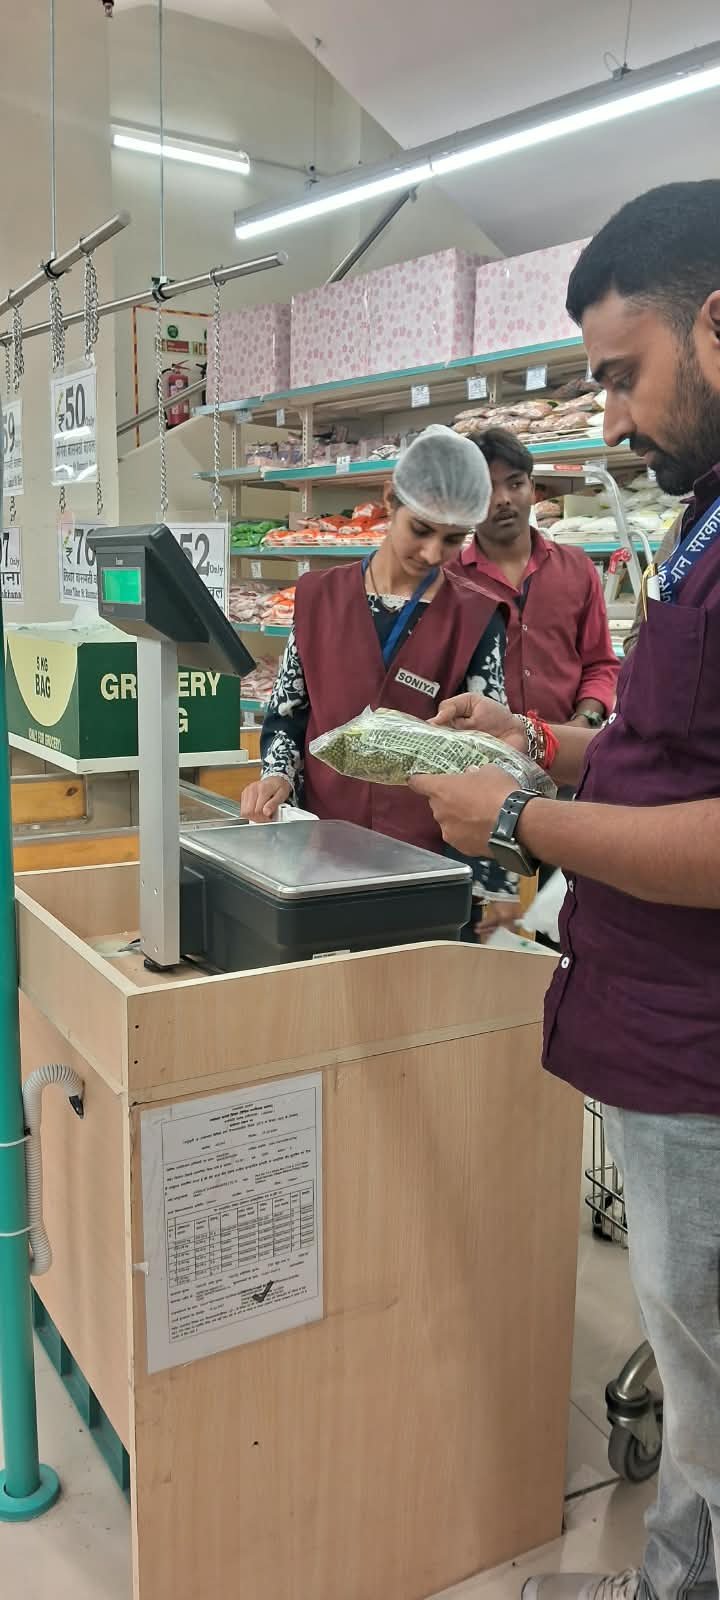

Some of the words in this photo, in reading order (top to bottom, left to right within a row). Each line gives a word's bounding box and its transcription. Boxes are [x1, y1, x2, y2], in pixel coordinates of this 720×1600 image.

[685, 505, 720, 552] सरका
[10, 557, 20, 568] Only
[209, 564, 224, 577] Only
[36, 656, 41, 670] 5
[40, 657, 48, 673] KG
[35, 673, 51, 699] BAG
[100, 671, 222, 701] GRERY
[397, 672, 436, 695] SONIYA
